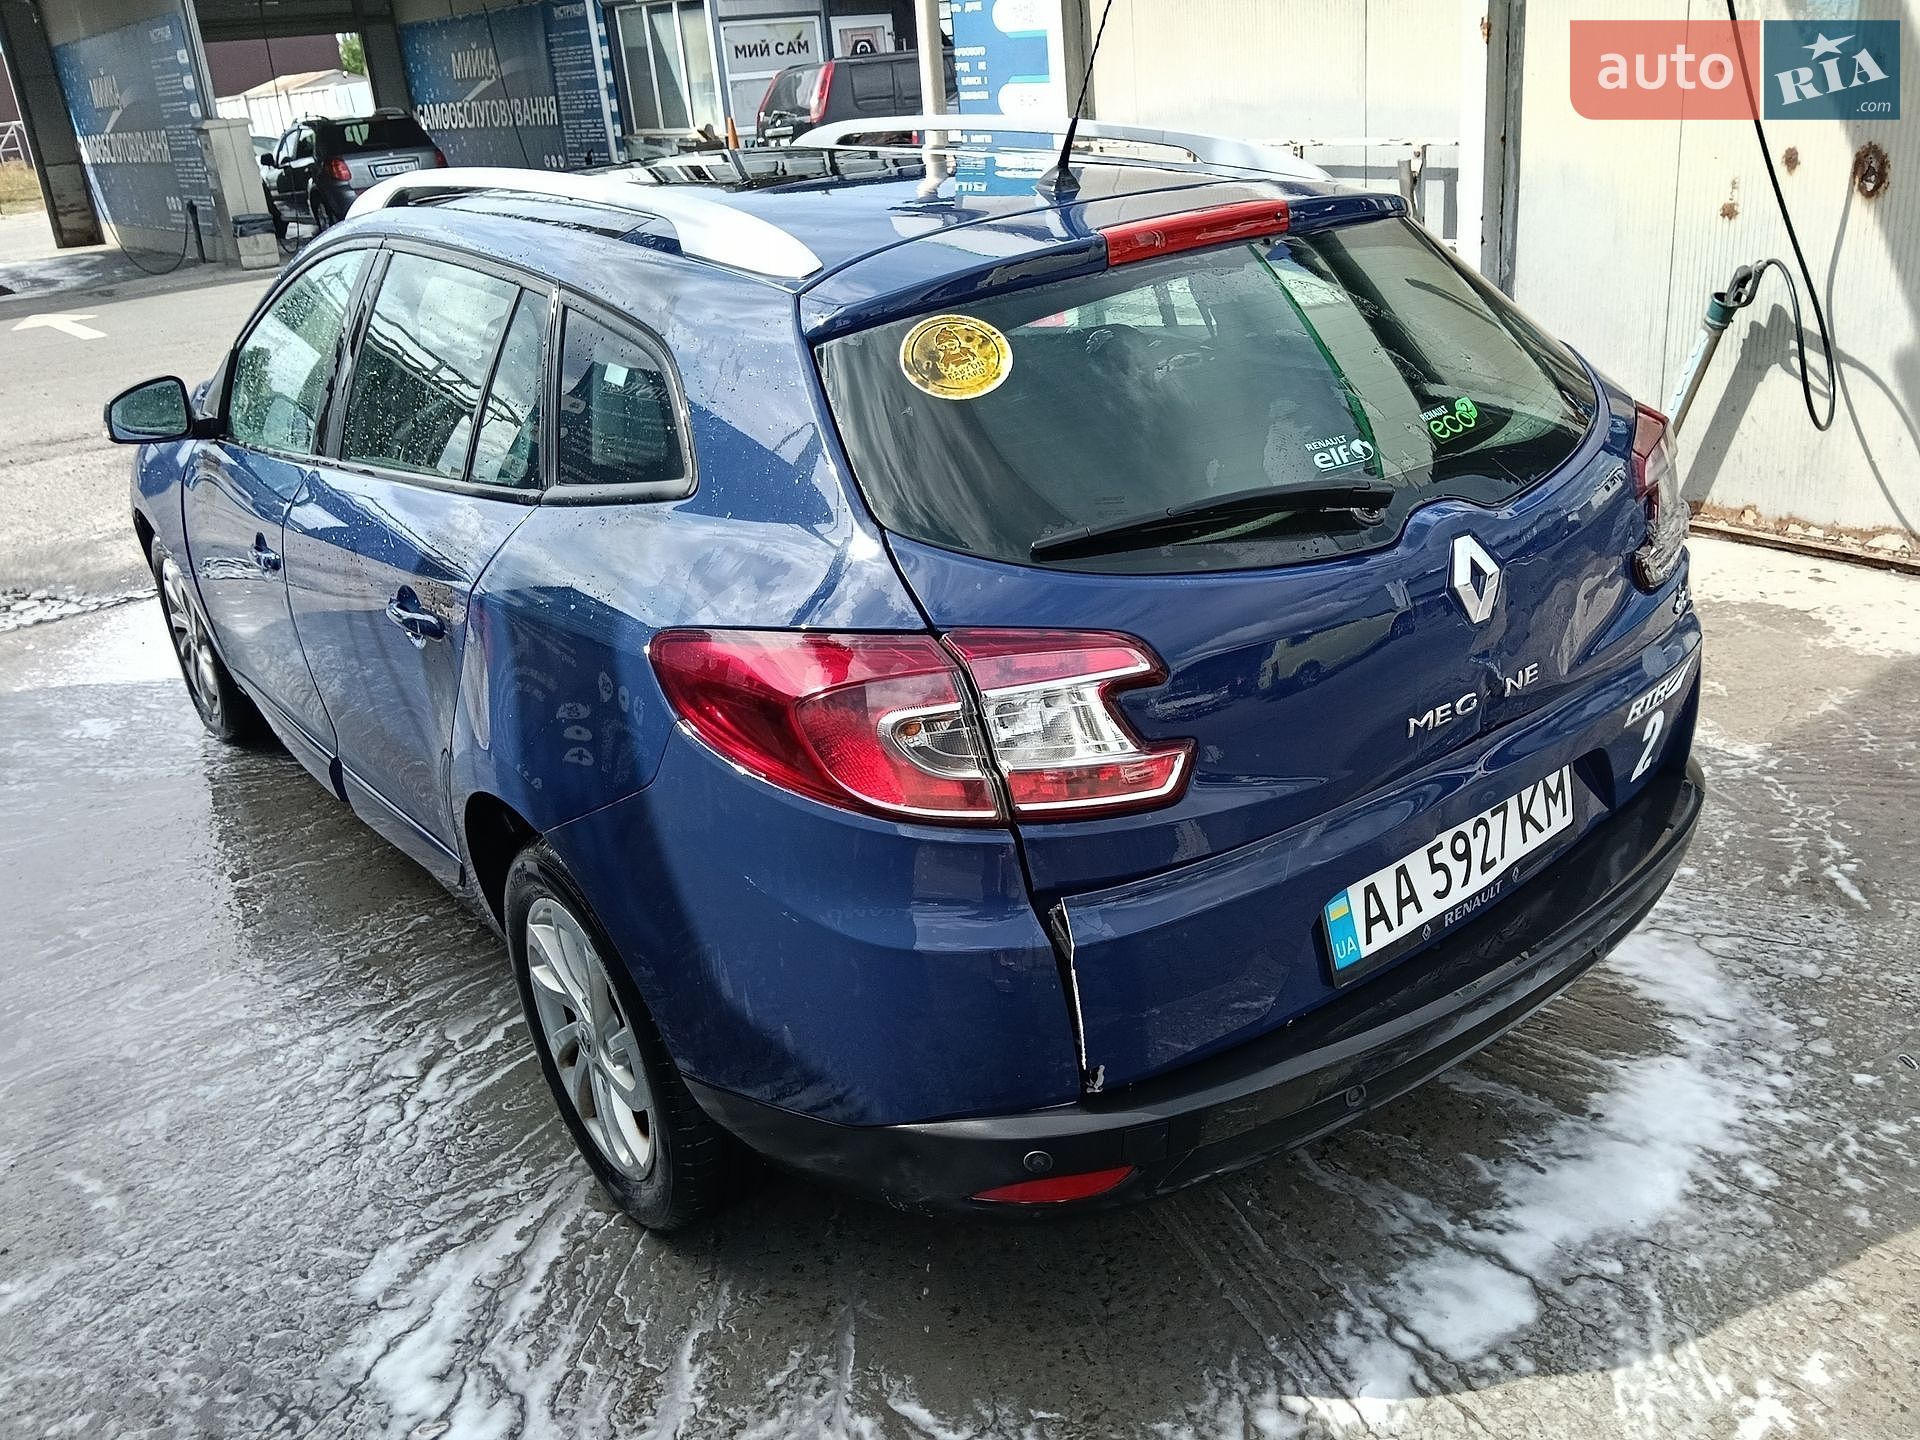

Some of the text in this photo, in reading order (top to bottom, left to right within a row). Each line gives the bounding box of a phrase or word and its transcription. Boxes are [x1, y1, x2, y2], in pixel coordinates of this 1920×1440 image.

[451, 42, 499, 80] МИЙКА
[734, 39, 810, 59] МИЙ САМ
[1418, 405, 1449, 422] RENAULT
[1304, 434, 1347, 451] RENAULT
[1313, 443, 1352, 469] elf
[1408, 662, 1539, 739] MEGNE
[1630, 710, 1665, 783] 2
[1363, 768, 1567, 946] AA 5927 KM
[1443, 879, 1504, 928] RENAULT
[1335, 941, 1358, 960] UA
